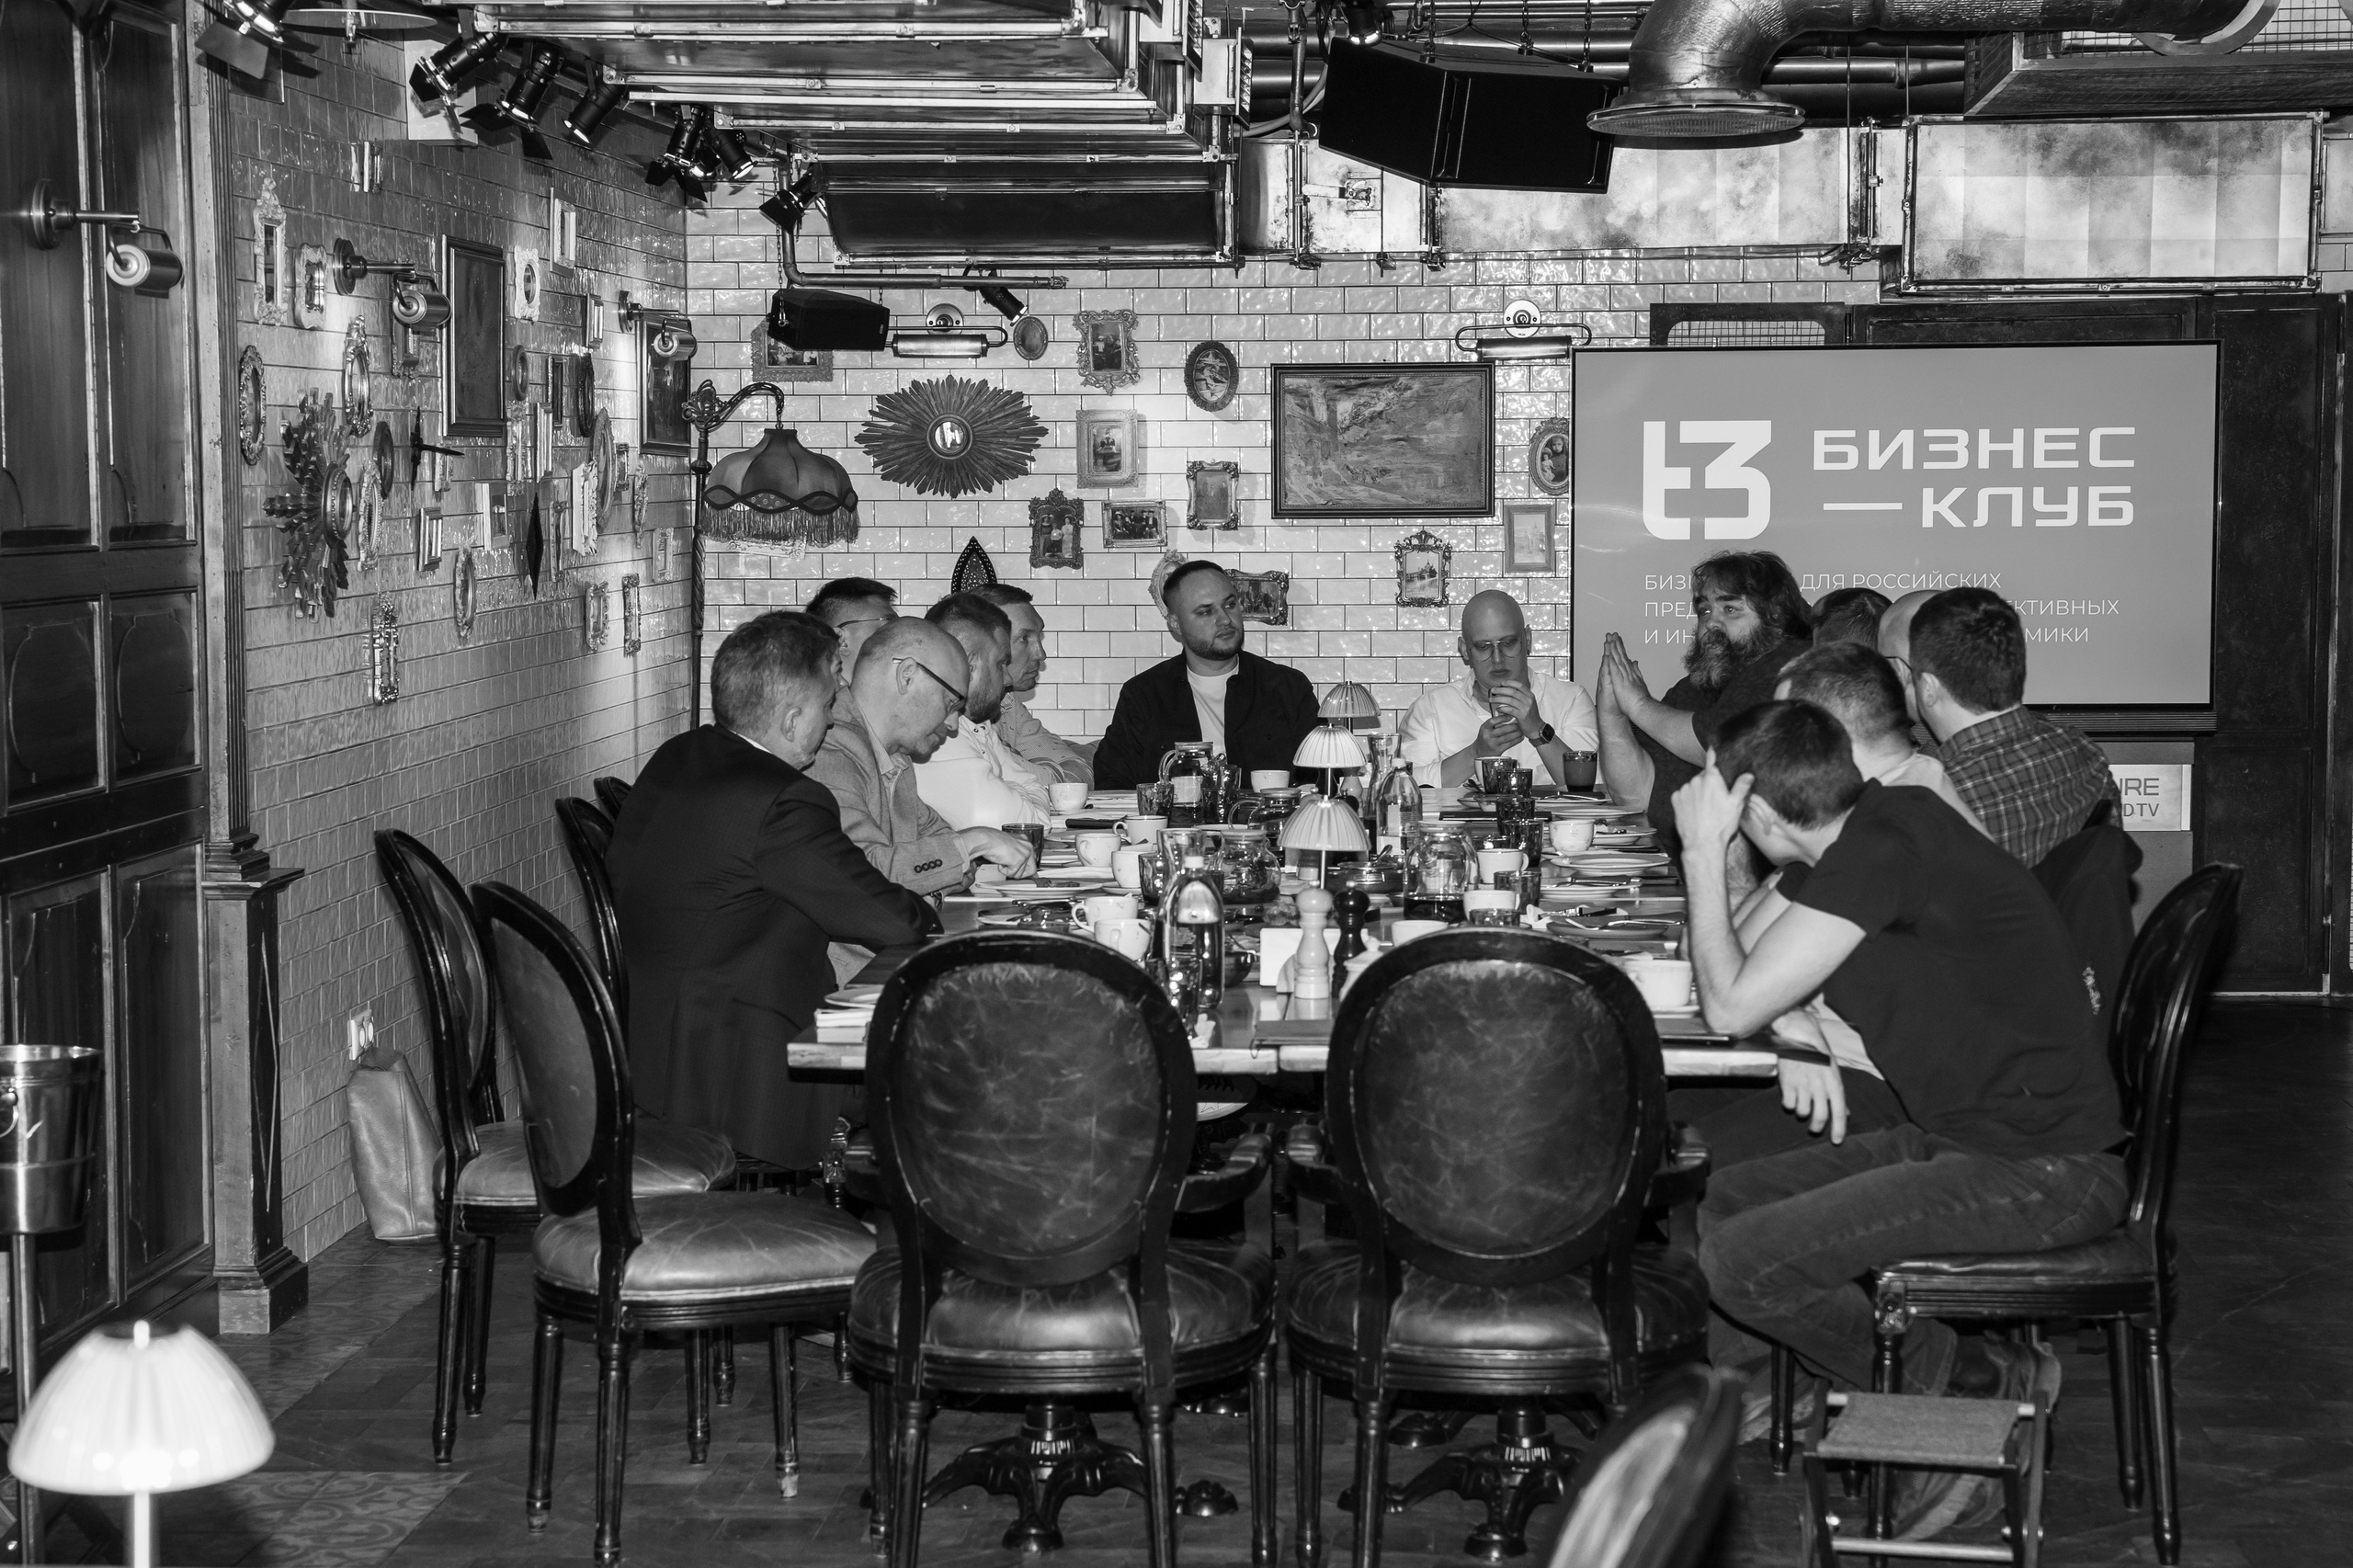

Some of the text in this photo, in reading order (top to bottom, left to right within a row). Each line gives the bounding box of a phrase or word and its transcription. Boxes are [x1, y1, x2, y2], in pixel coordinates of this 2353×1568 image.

[1813, 426, 2136, 471] БИЗНЕС
[1921, 485, 2135, 528] КЛУБ
[1644, 570, 2002, 592] БИЗ ДЛЯ РОССИЙСКИХ
[1644, 599, 2120, 620] ПРЕД КТИВНЫХ
[1644, 627, 2089, 644] И ИН МИКИ
[2122, 802, 2160, 817] DTV
